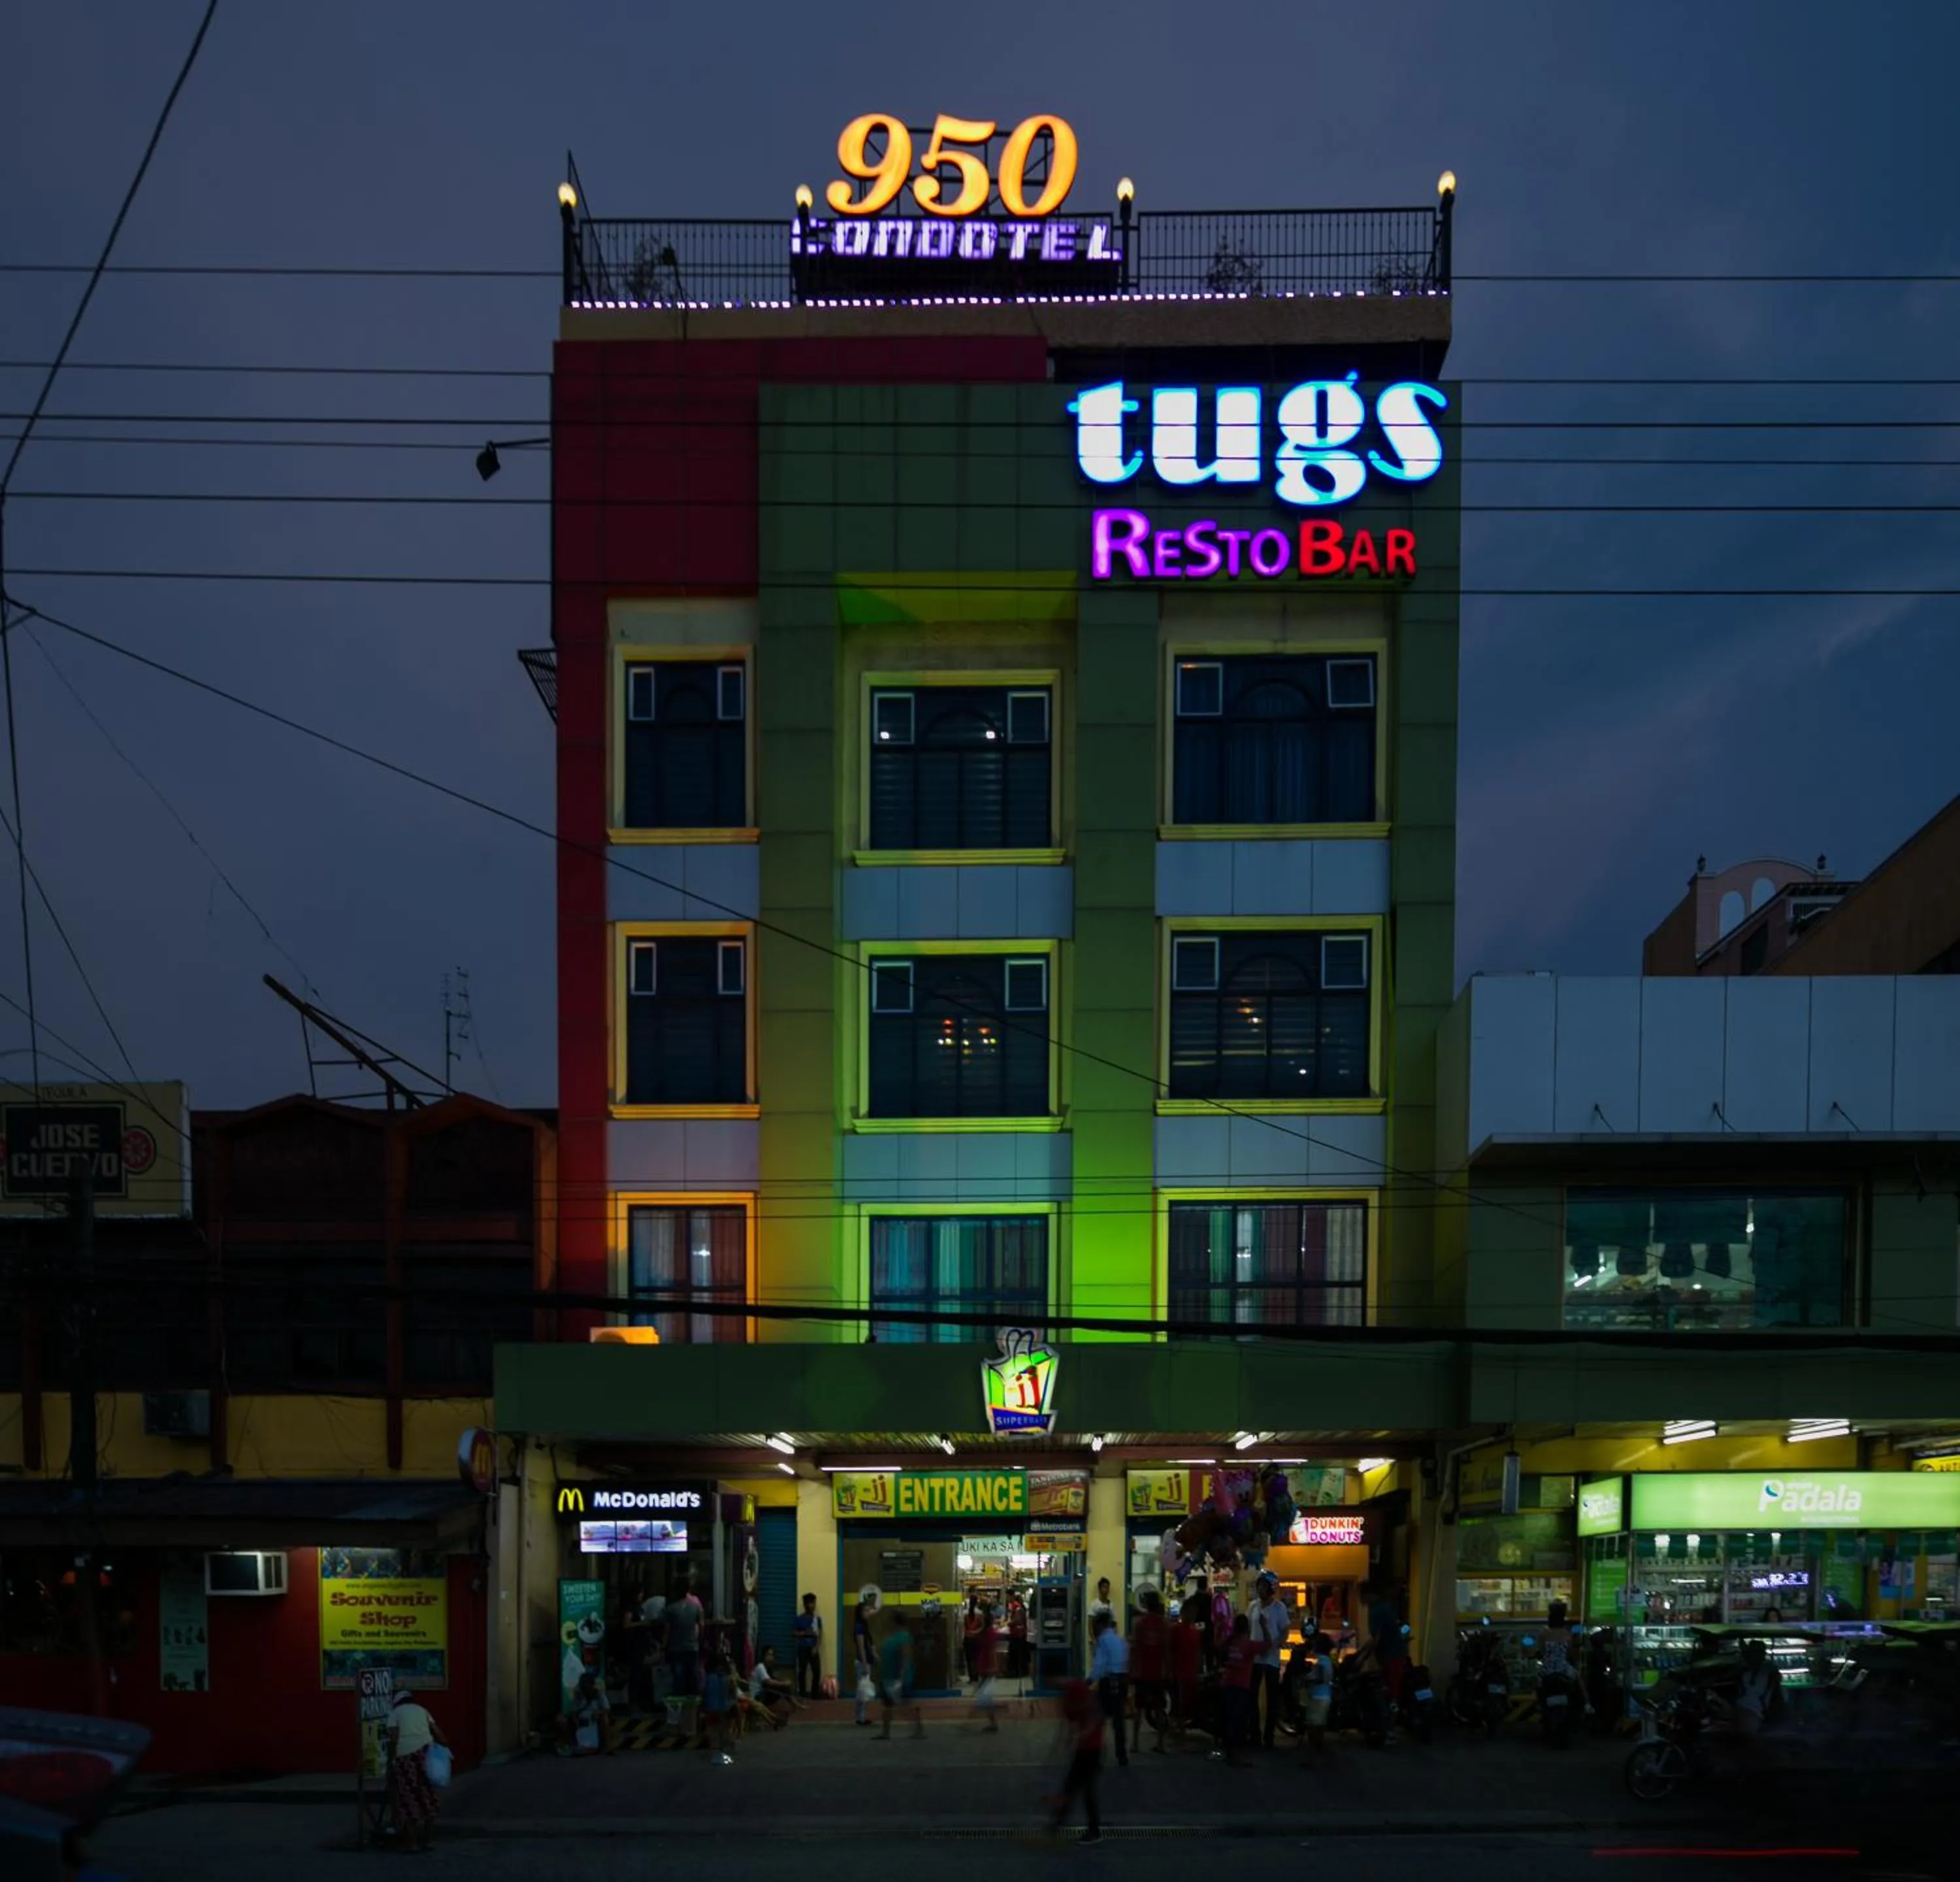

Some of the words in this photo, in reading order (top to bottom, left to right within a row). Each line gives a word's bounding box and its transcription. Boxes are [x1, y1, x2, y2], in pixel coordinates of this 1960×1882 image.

[826, 113, 1078, 217] 950
[791, 219, 1122, 261] CONDOTEL
[1067, 368, 1448, 508] tugs
[29, 1123, 99, 1149] JOSE
[593, 1491, 701, 1508] McDonald's
[899, 1476, 1022, 1512] ENTRANCE
[1758, 1479, 1861, 1513] Padala
[1309, 1531, 1361, 1544] DONUTS
[330, 1591, 438, 1607] Souvenir
[360, 1611, 417, 1628] Shop
[374, 1671, 389, 1694] NO
